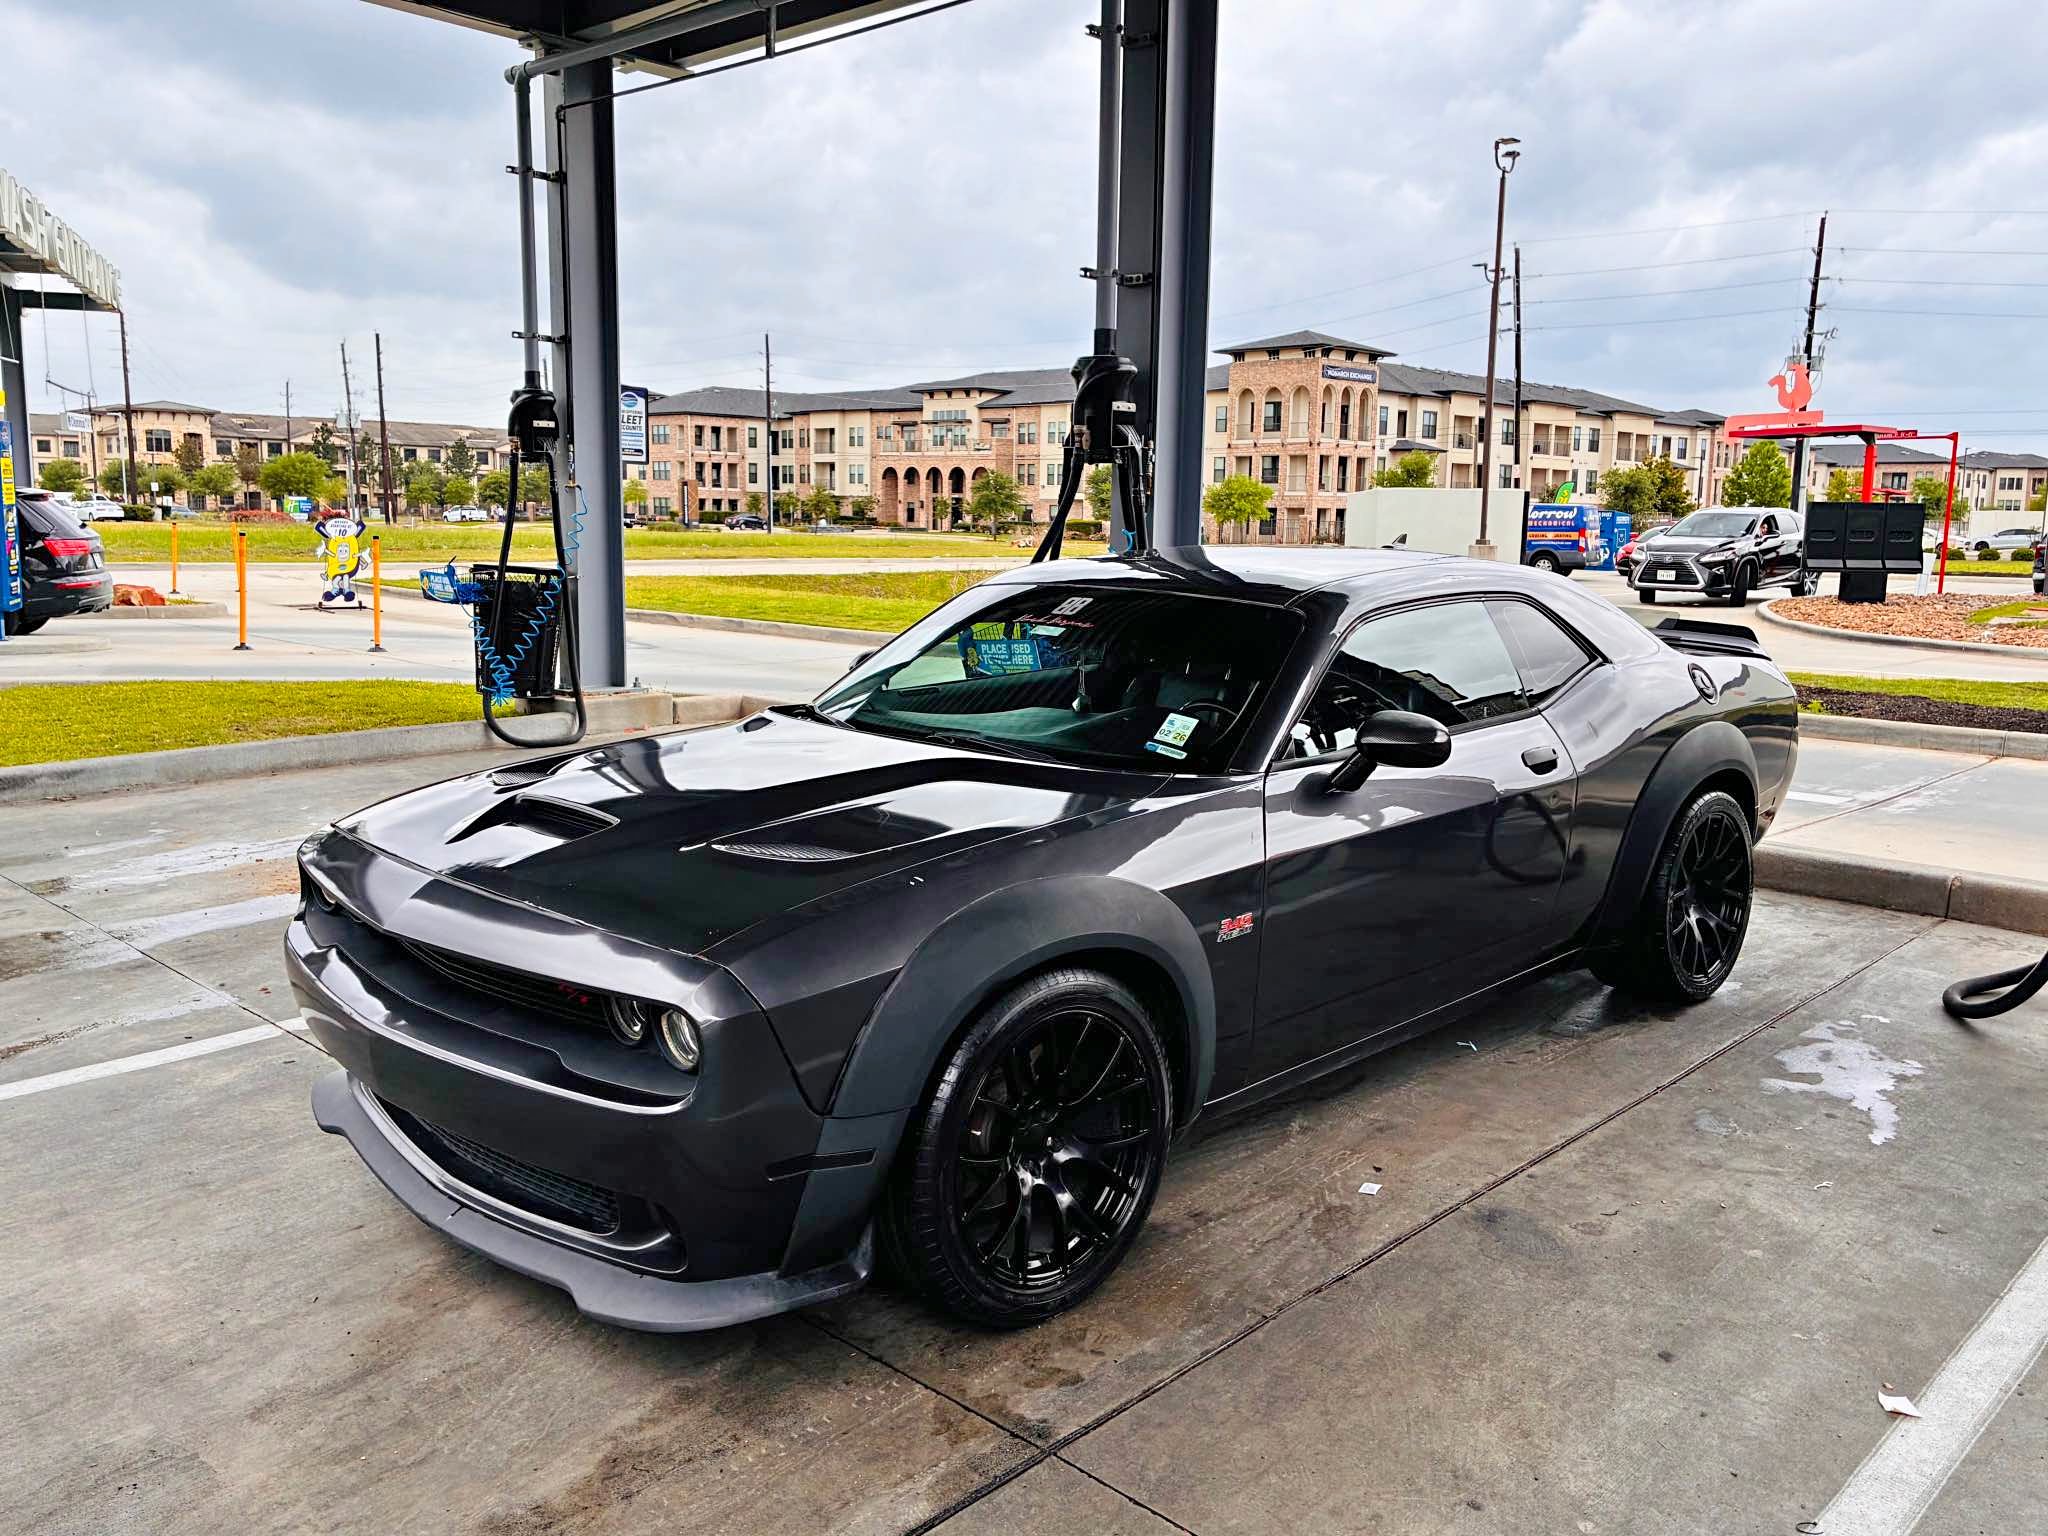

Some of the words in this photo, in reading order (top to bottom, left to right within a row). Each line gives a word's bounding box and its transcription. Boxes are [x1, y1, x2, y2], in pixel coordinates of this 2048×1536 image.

[1326, 369, 1349, 379] MONARCH
[1350, 371, 1373, 381] EXCHANGE
[621, 415, 643, 425] LEET
[981, 643, 1007, 653] PLACE
[1012, 654, 1033, 664] HERE
[1158, 728, 1171, 737] 02
[1172, 732, 1186, 741] 26
